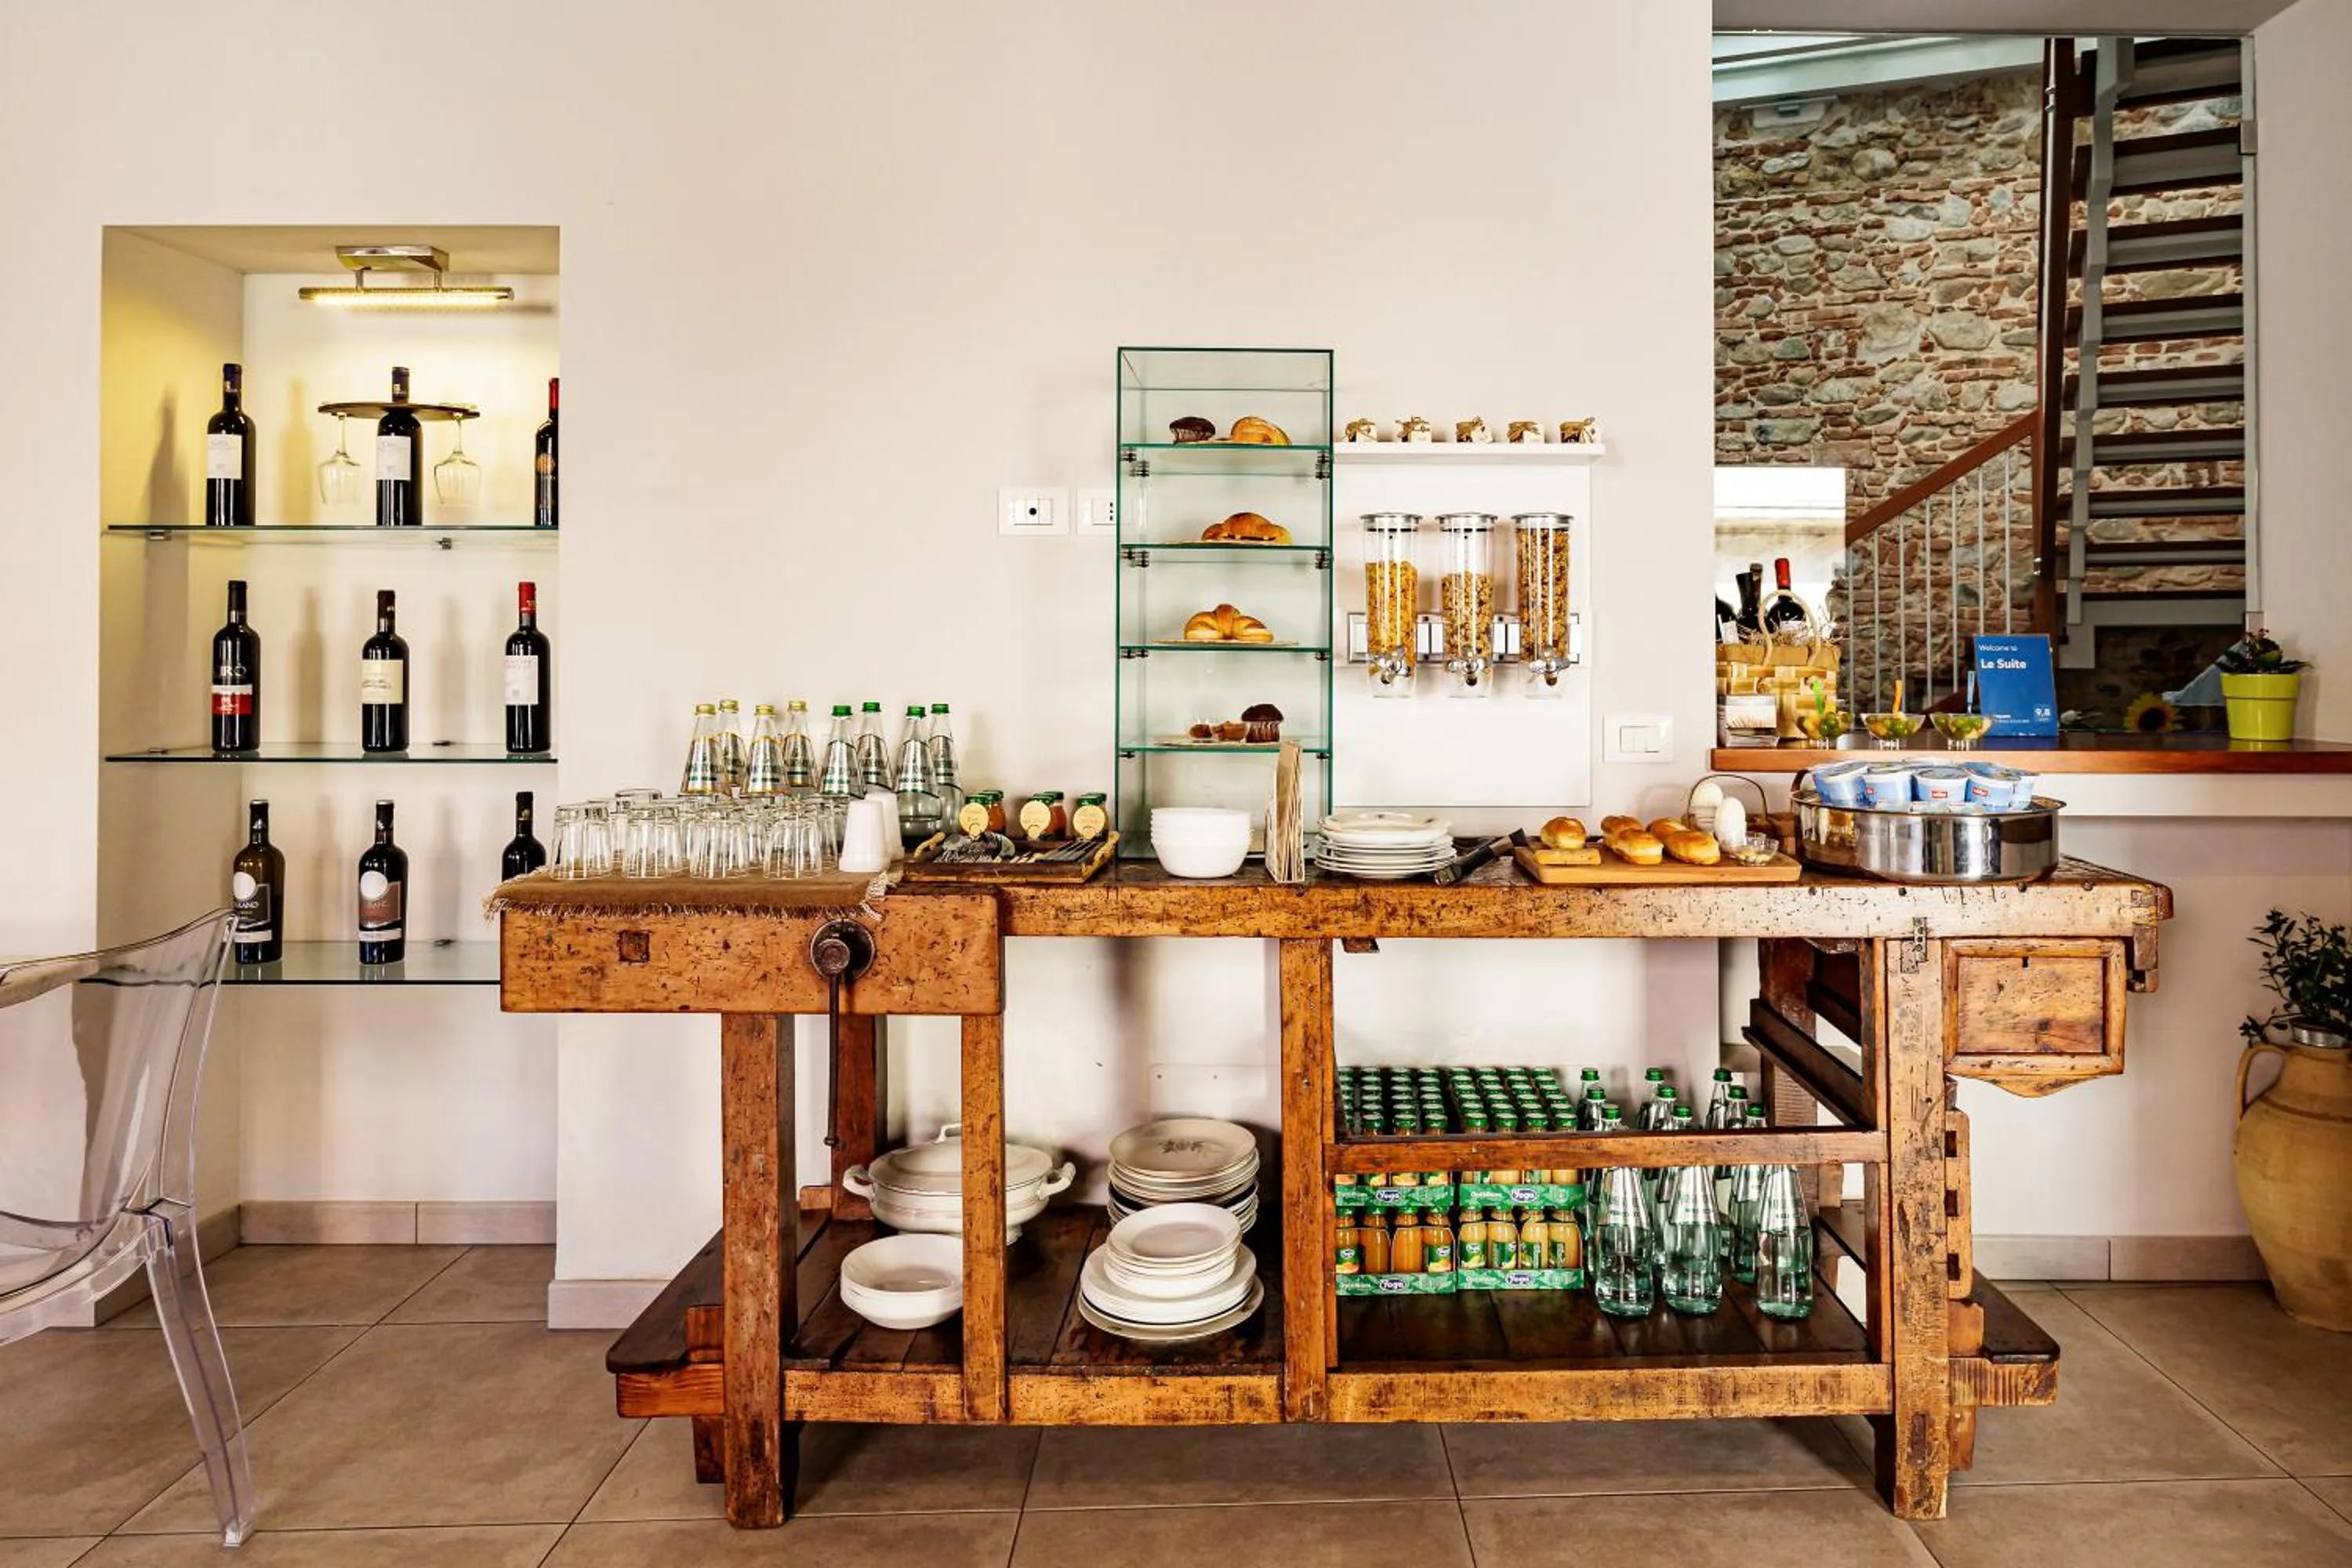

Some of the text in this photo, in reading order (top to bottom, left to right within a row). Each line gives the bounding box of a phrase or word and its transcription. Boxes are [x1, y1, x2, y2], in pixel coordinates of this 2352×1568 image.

[1981, 658, 2027, 669] Le Suite
[1377, 1190, 1401, 1200] Yoga
[1513, 1189, 1534, 1201] Yoga
